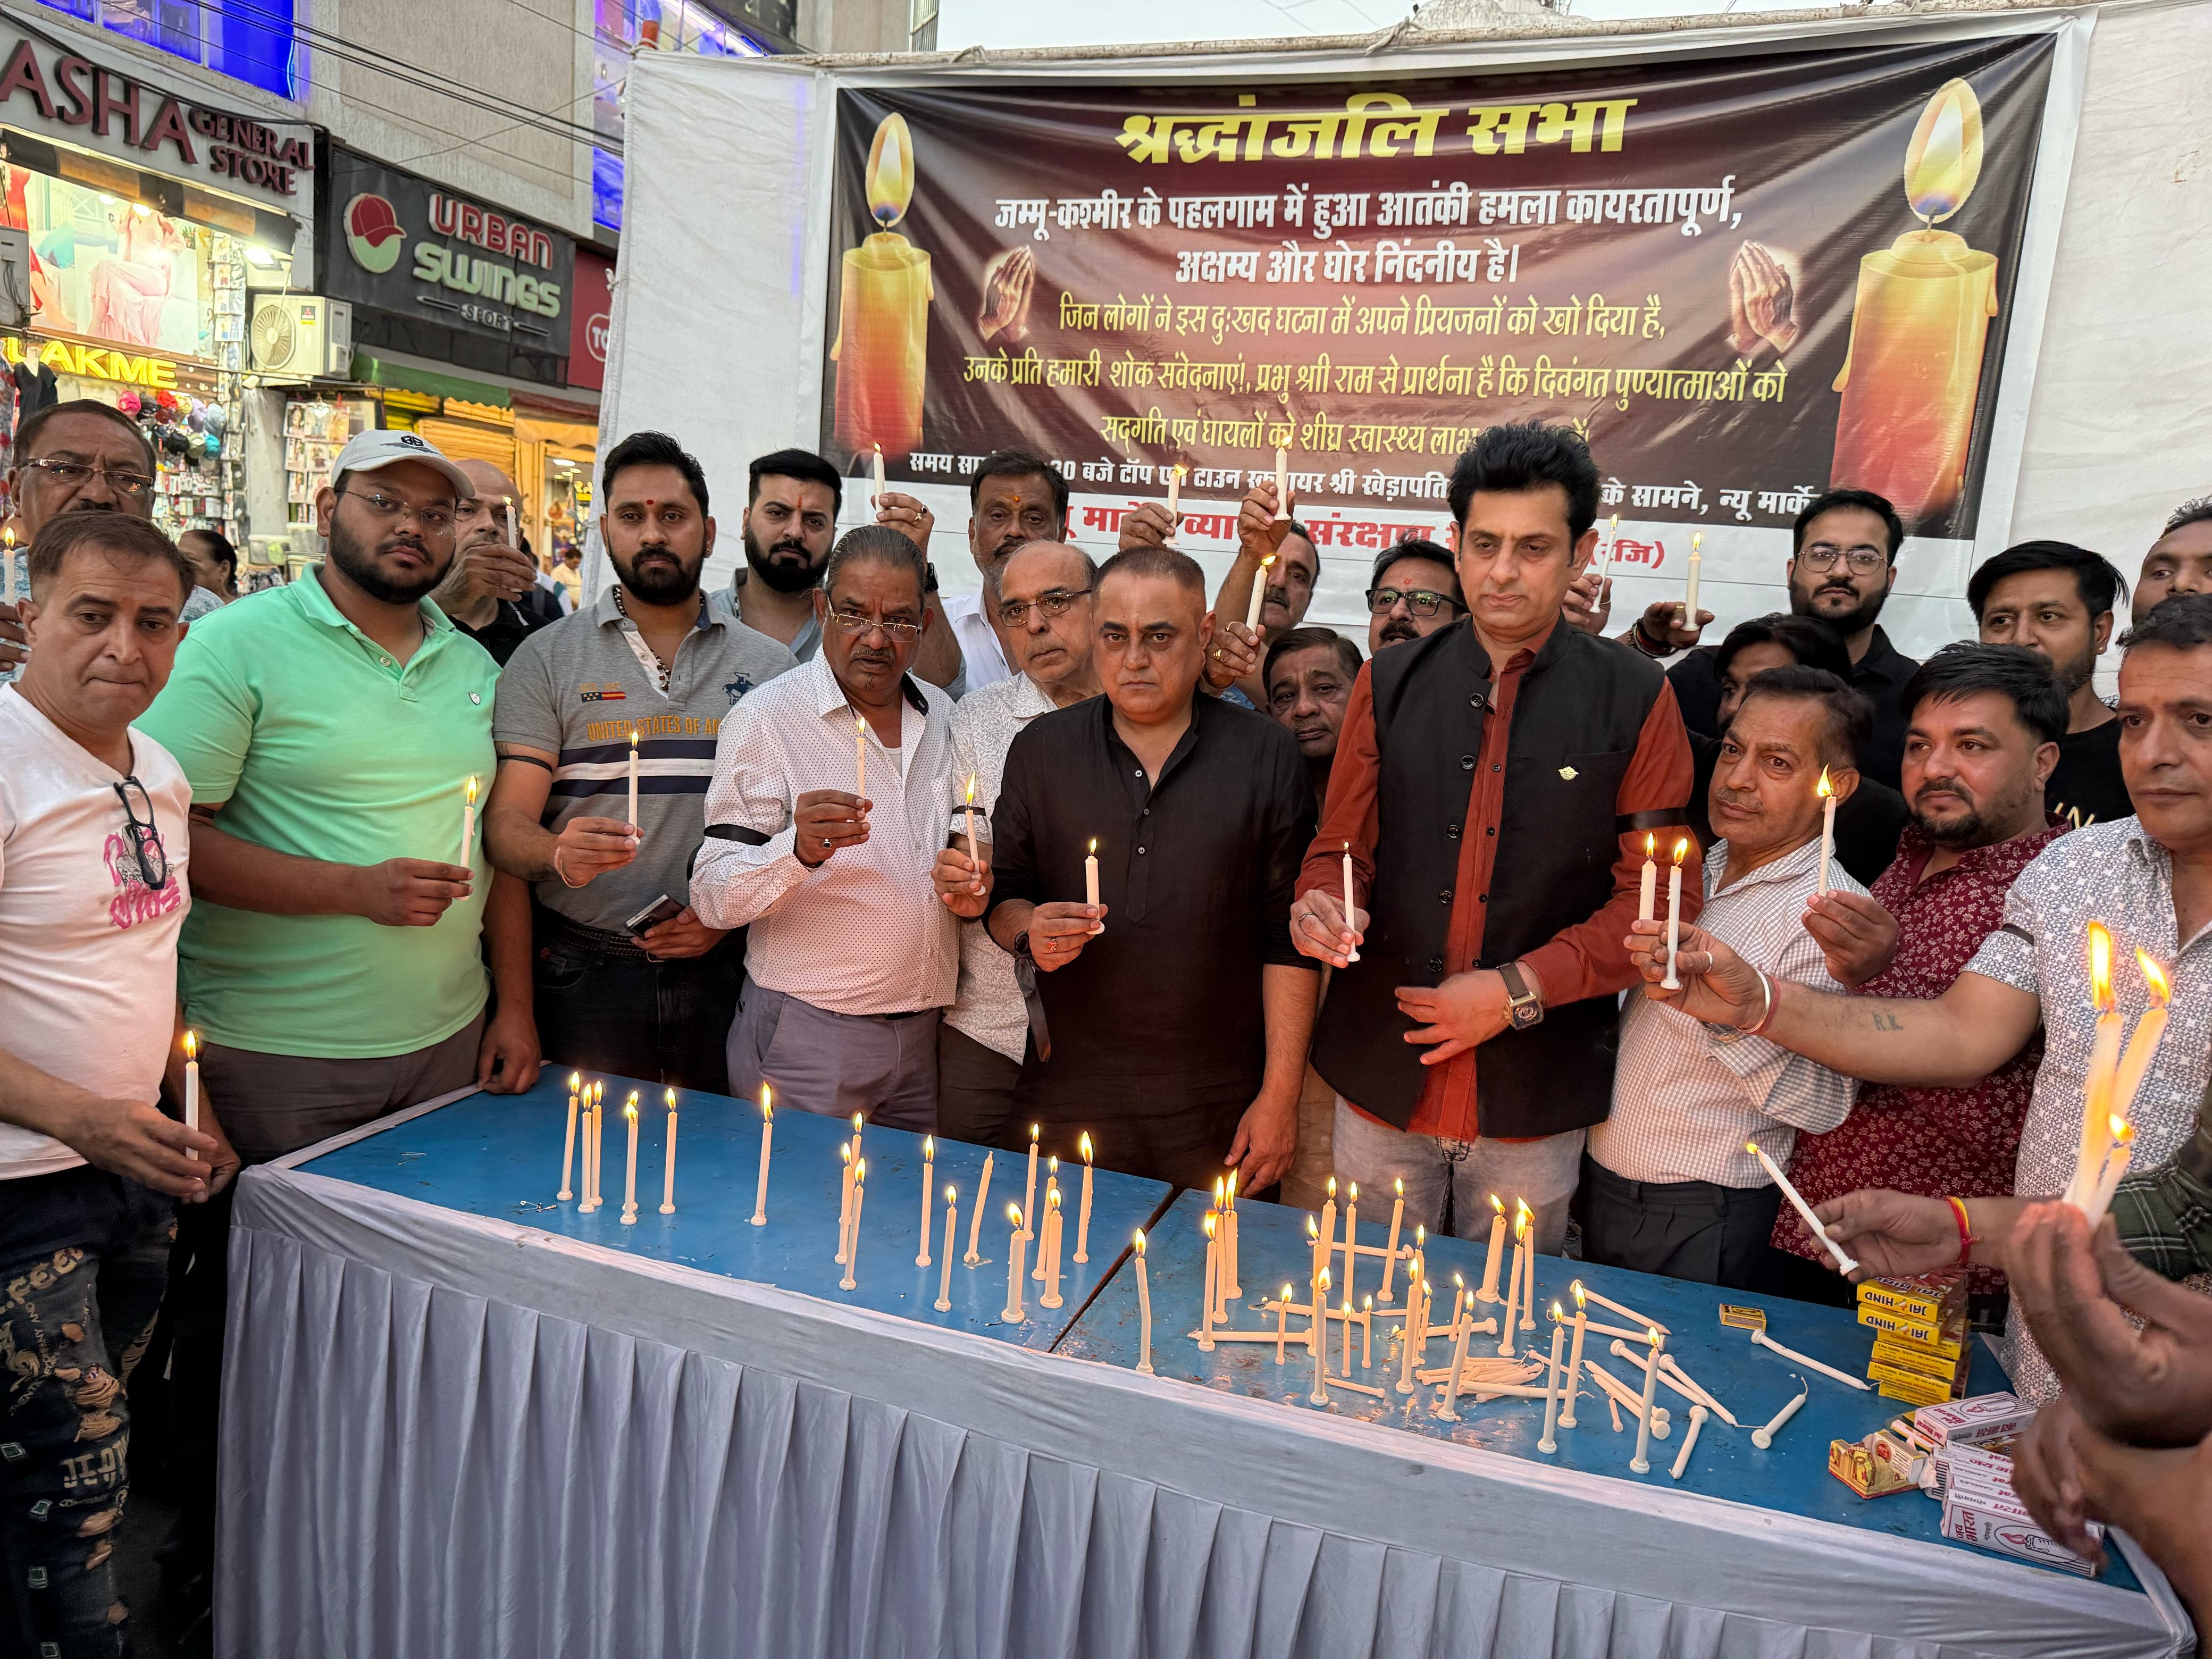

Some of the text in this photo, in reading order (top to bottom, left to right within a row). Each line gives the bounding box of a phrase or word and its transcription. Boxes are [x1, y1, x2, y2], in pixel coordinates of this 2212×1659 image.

[0, 39, 198, 164] ASHA
[189, 106, 316, 171] GENERAL
[1115, 92, 1639, 163] श्रद्धांजलि सभा
[210, 146, 297, 196] STORE
[429, 193, 552, 270] URBAN
[995, 175, 1742, 241] जम्मू-कश्मीर के पहलगाम में हुआ आतंकी हमला कायरतापूर्ण,
[413, 241, 561, 319] SWINGS
[1175, 250, 1261, 283] अक्षम्य
[1266, 240, 1319, 283] और
[1323, 240, 1370, 283] घोर
[1375, 239, 1481, 283] निंदनीय
[1059, 291, 1100, 330] जिन
[1103, 293, 1154, 331] लोगों
[1154, 294, 1173, 332] ने
[1175, 306, 1209, 337] इस
[1275, 305, 1328, 334] घटना
[1330, 294, 1355, 335] में
[1355, 294, 1411, 335] अपने
[1413, 294, 1507, 336] प्रियजनों
[1506, 294, 1539, 336] को
[1541, 294, 1582, 336] खो
[1586, 293, 1639, 339] दिया
[6, 336, 179, 391] LAKME
[963, 346, 1010, 384] उनके
[1010, 347, 1044, 386] प्रति
[1046, 348, 1102, 388] हमारी
[1108, 349, 1155, 388] शोक
[1255, 364, 1293, 405] प्रभु
[1334, 365, 1376, 393] राम
[1378, 354, 1401, 395] से
[1401, 355, 1471, 396] प्रार्थना
[1476, 355, 1494, 398] है
[1497, 354, 1528, 397] कि
[1532, 355, 1611, 399] दिवंगत
[1615, 358, 1749, 412] पुण्यात्माओं
[1753, 359, 1788, 403] को
[1171, 408, 1199, 450] एवं
[1202, 410, 1265, 448] घायलों
[1268, 410, 1296, 450] को
[1300, 410, 1345, 452] शीघ्र
[1347, 424, 1427, 454] स्वास्थ्य
[909, 453, 953, 473] समय
[1082, 456, 1115, 482] बजे
[1120, 458, 1154, 484] टॉप
[1193, 467, 1243, 489] टाउन
[1329, 468, 1357, 495] श्री
[1631, 480, 1709, 516] सामने,
[1720, 488, 1753, 522] न्यू
[587, 720, 632, 742] UNITED
[638, 715, 682, 735] STATES
[685, 717, 700, 734] OF
[1865, 1291, 1927, 1316] JAI HIND
[1866, 1316, 1929, 1340] JAI HIND
[1933, 1407, 1967, 1423] Bharat
[1955, 1522, 1965, 1539] जय
[1962, 1509, 1978, 1542] भारत
